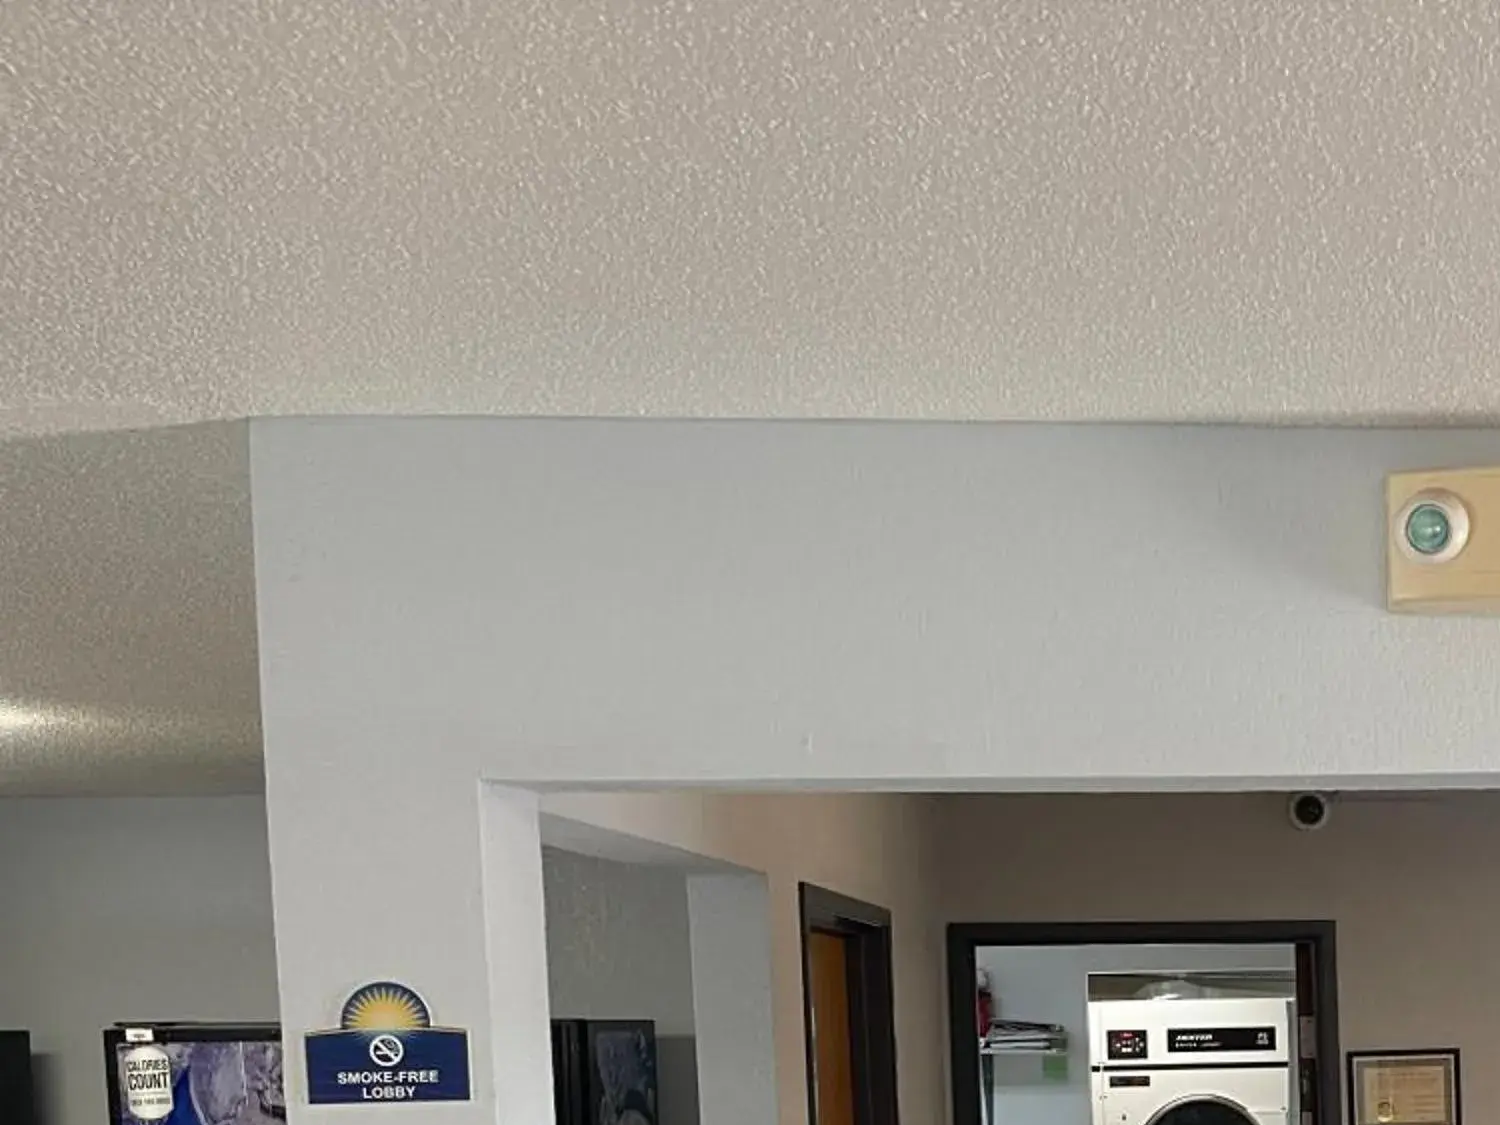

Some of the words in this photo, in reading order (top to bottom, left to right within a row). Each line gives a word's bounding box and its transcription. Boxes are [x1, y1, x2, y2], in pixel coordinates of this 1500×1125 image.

[128, 1072, 170, 1090] COUNT
[337, 1069, 439, 1084] SMOKE-FREE
[362, 1086, 416, 1099] LOBBY
